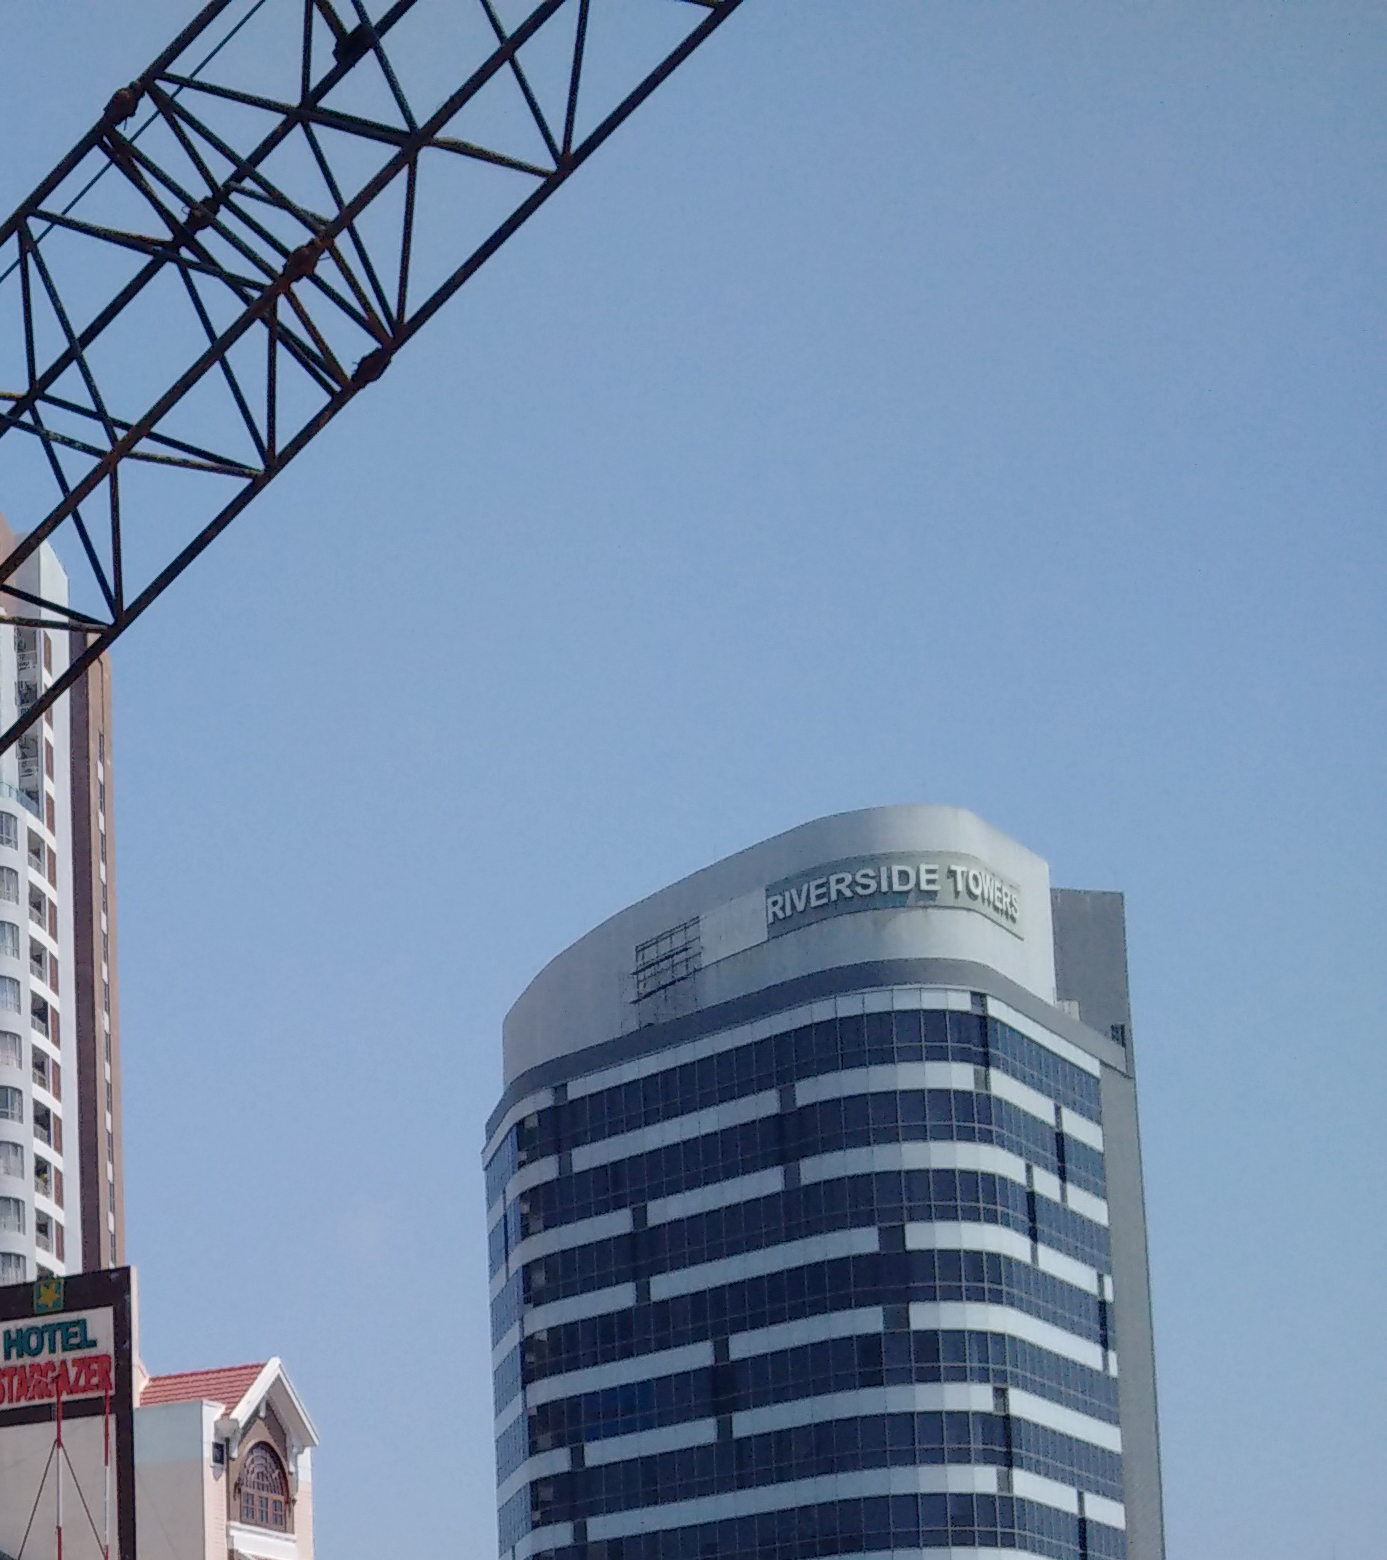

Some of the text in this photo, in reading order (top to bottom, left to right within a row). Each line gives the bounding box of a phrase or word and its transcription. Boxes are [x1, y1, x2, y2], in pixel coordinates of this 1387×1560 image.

[767, 863, 1020, 925] RIVERSIDE TOWERS
[2, 1318, 98, 1361] HOTEL
